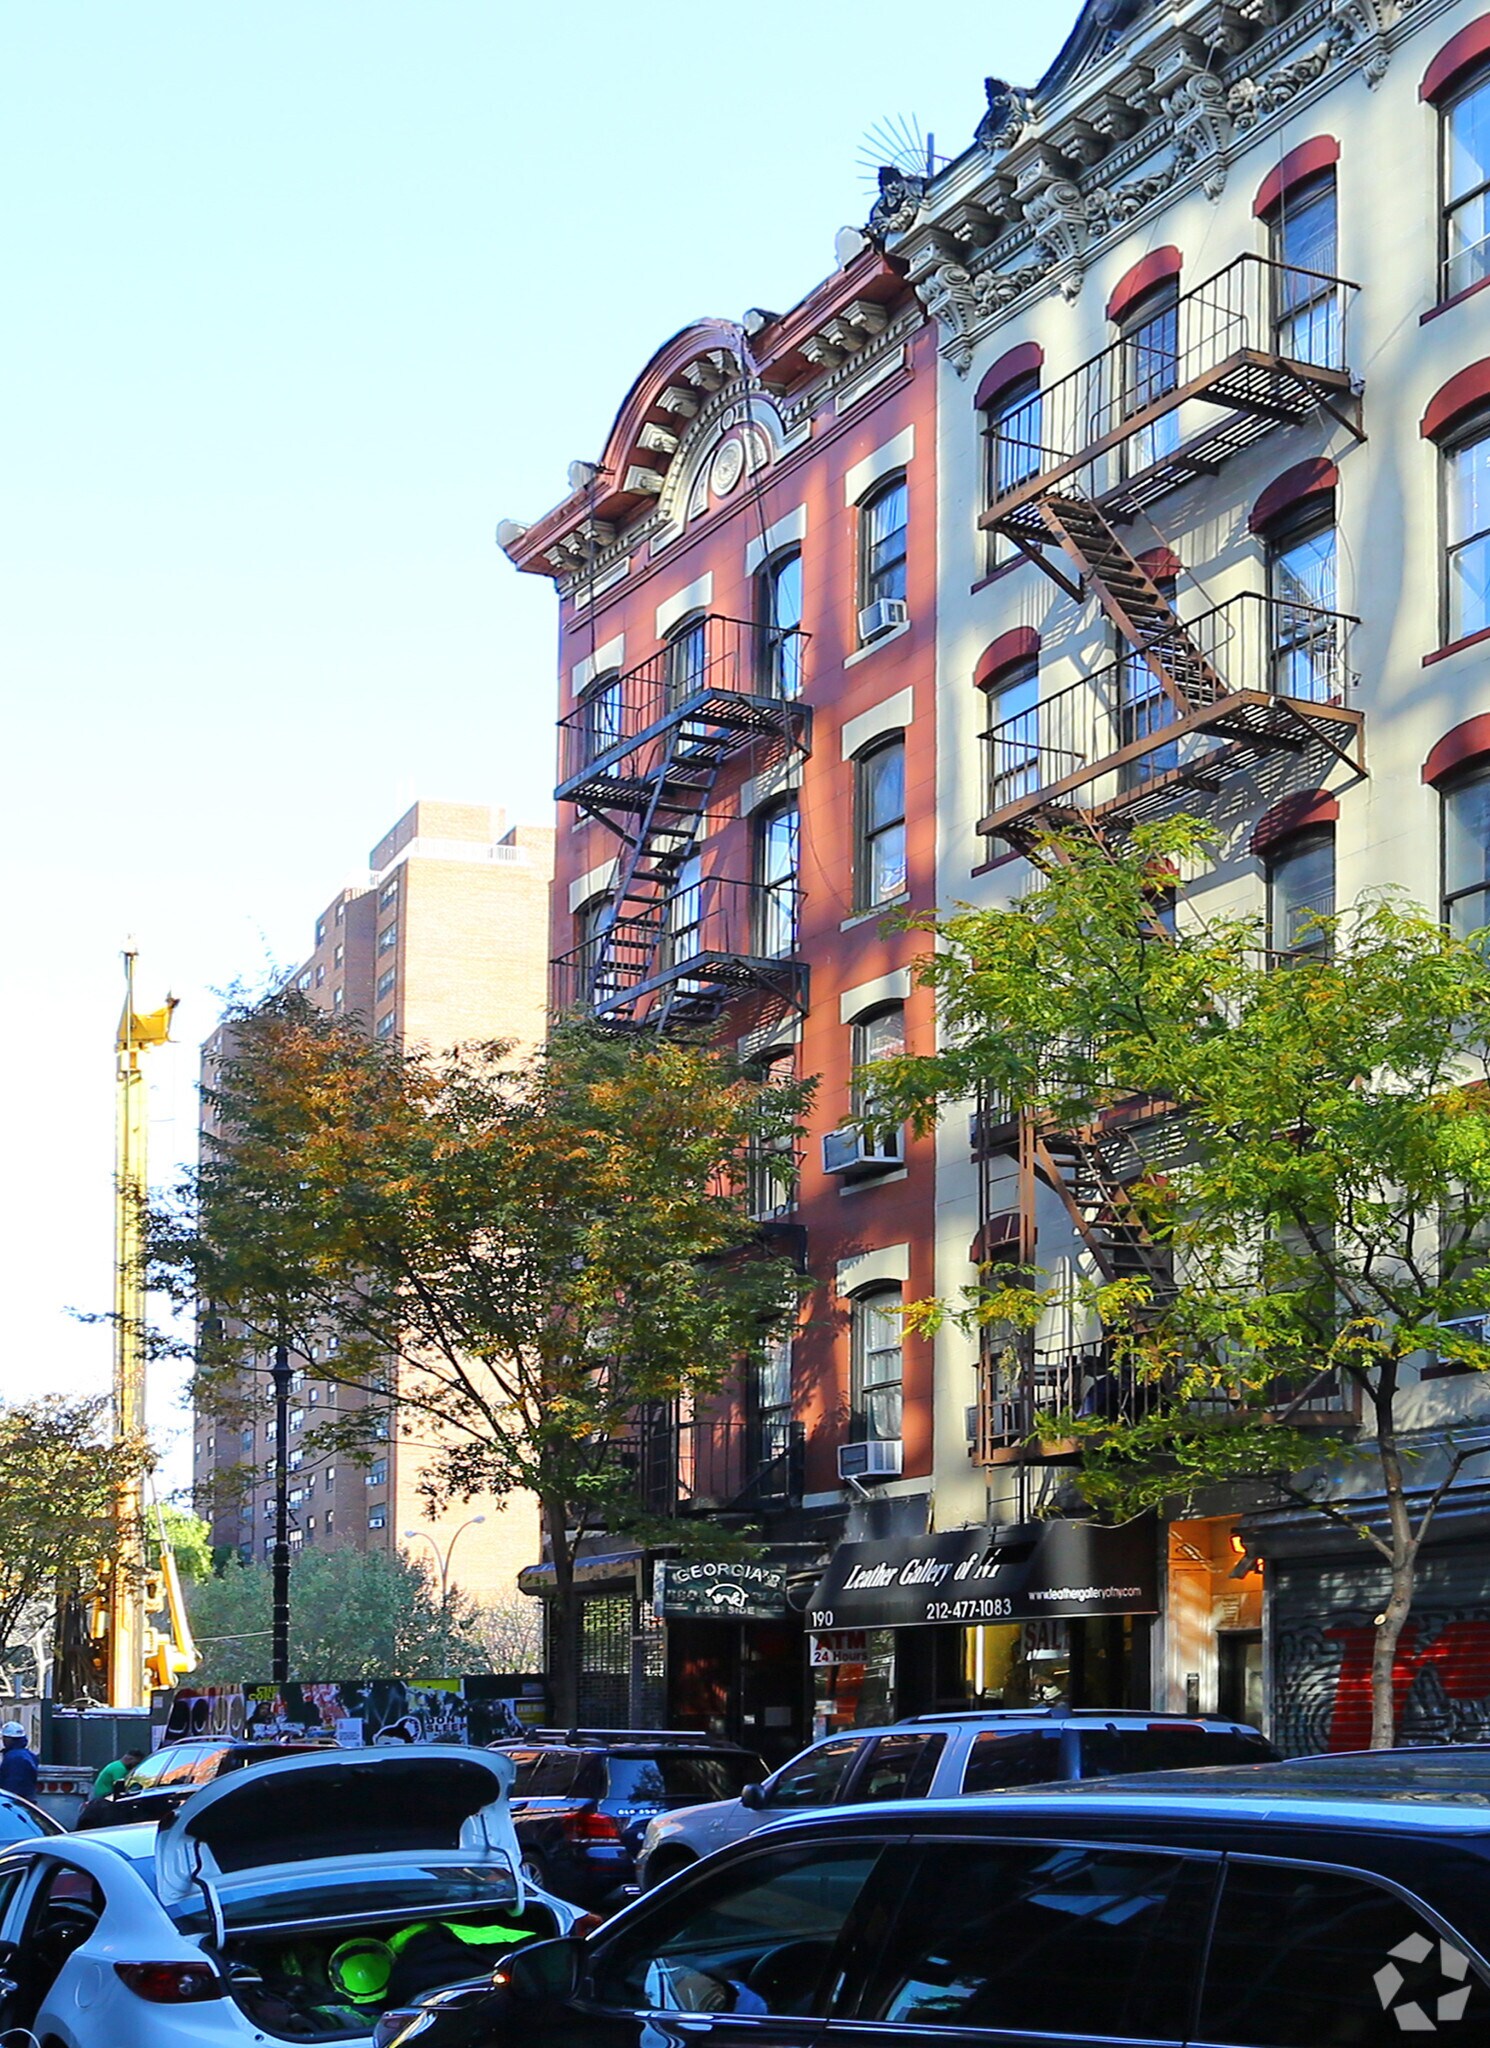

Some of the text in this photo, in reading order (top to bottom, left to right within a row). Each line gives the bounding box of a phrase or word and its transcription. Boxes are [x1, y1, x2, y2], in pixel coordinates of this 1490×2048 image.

[842, 1562, 899, 1590] Leather
[898, 1557, 953, 1587] Gallery
[953, 1552, 979, 1581] of
[727, 1604, 756, 1615] SIDE
[926, 1598, 1012, 1620] 212-477-1083
[811, 1610, 834, 1627] 190
[816, 1630, 867, 1650] ATM
[1024, 1620, 1069, 1651] SAL
[814, 1651, 868, 1663] 24 Hours
[425, 1724, 468, 1733] SLEEP
